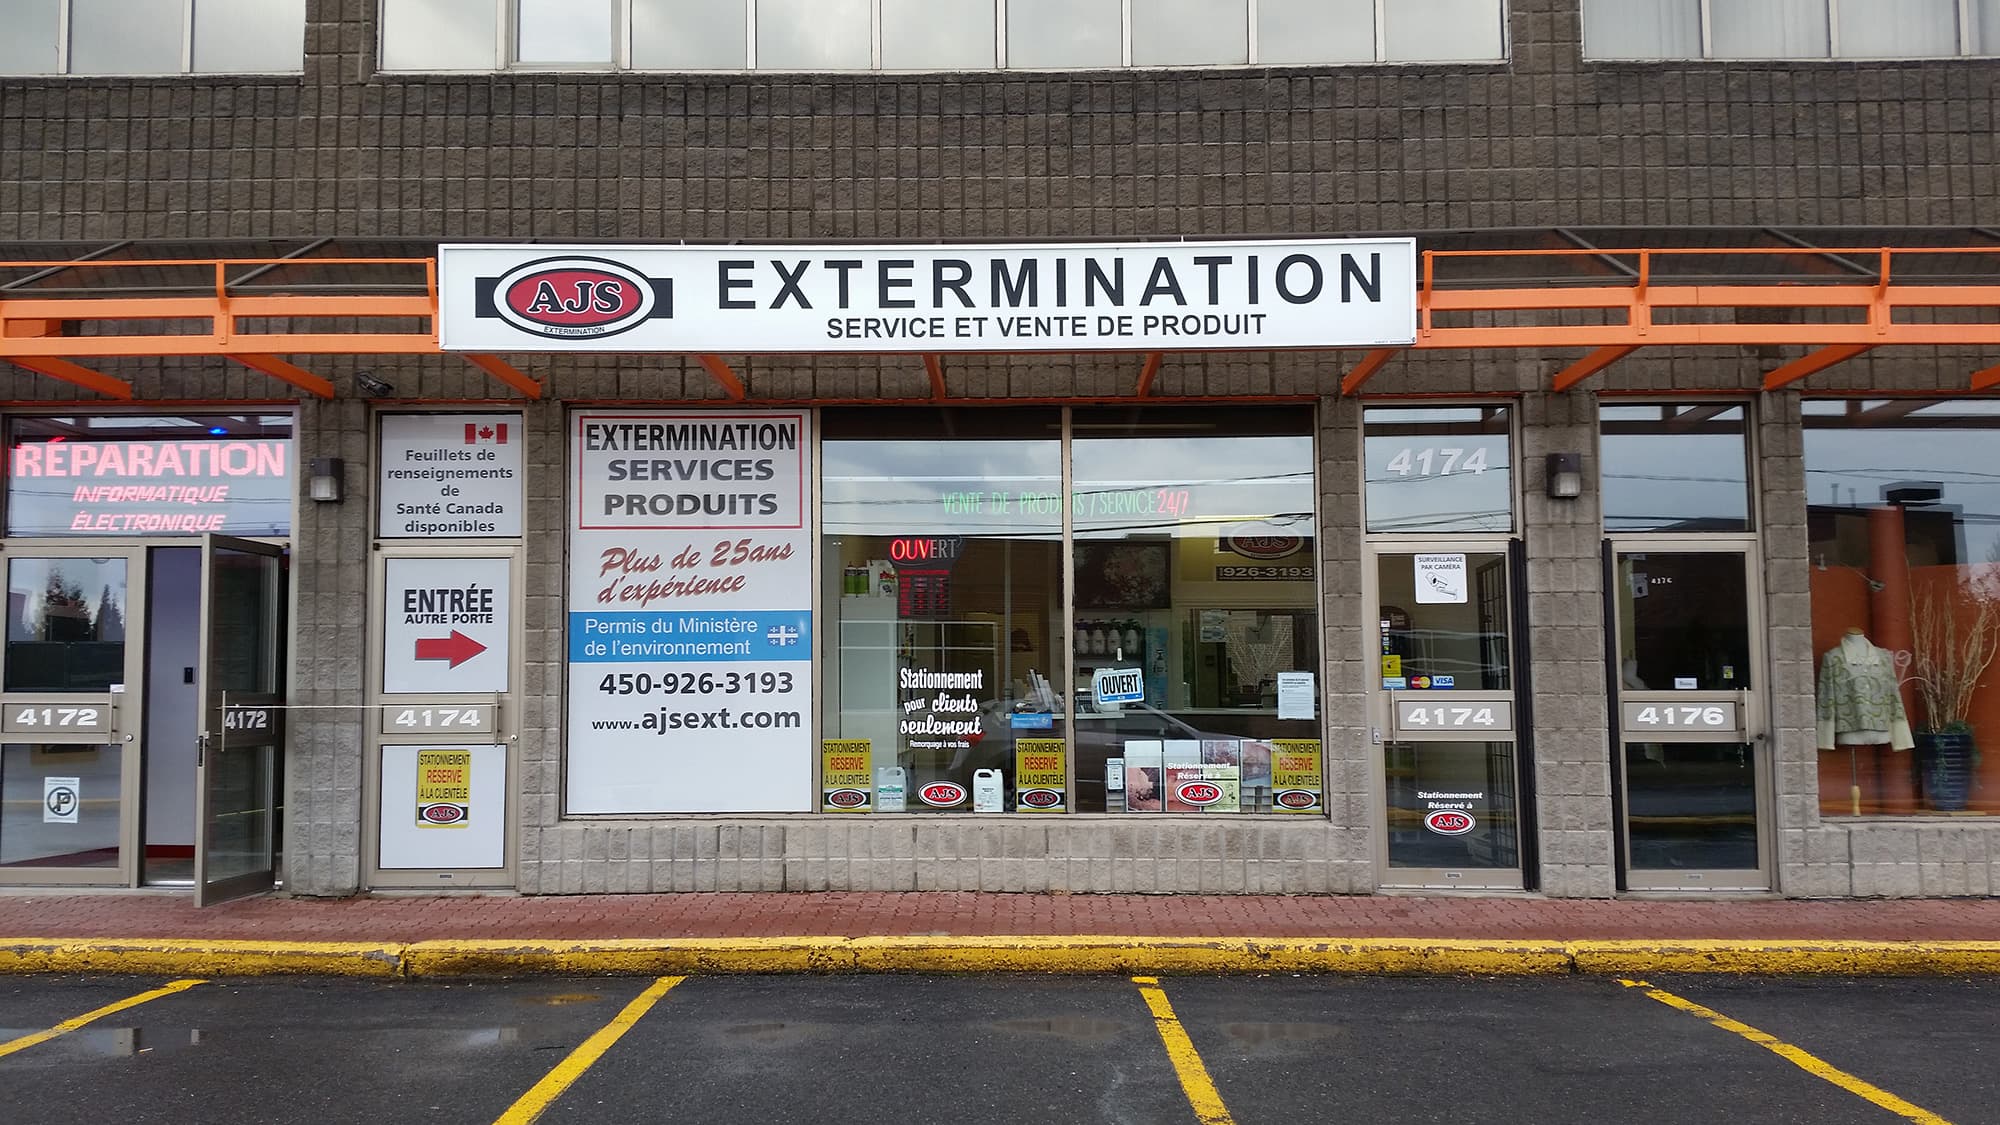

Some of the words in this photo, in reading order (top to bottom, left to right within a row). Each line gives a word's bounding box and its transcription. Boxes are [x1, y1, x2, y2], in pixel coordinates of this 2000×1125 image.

[718, 252, 1381, 309] EXTERMINATION
[527, 280, 623, 314] AJS
[543, 325, 605, 336] EXTERMINATION
[827, 317, 945, 339] SERVICE
[954, 316, 988, 338] ET
[997, 315, 1087, 338] VENTE
[1099, 315, 1133, 337] DE
[1144, 313, 1266, 337] PRODUIT
[586, 423, 796, 451] EXTERMINATION
[15, 437, 285, 477] RÉPARATION
[406, 449, 471, 461] Feuillets
[477, 449, 496, 461] de
[1387, 448, 1487, 475] 4174
[388, 467, 513, 481] renseignements
[608, 459, 775, 481] SERVICES
[72, 485, 229, 504] INFORMATIQUE
[441, 485, 460, 496] de
[397, 502, 441, 514] Santé
[446, 502, 503, 514] Canada
[604, 493, 778, 516] PRODUITS
[942, 491, 984, 515] VENTE
[992, 491, 1010, 515] DE
[71, 511, 227, 533] ÉLECTRONIQUE
[405, 520, 495, 535] disponibles
[600, 546, 664, 577] Plus
[671, 544, 702, 570] de
[710, 538, 795, 568] 25ans
[891, 538, 957, 560] OUVERT
[404, 583, 493, 613] ENTRÉE
[597, 574, 747, 608] d'expérience
[405, 614, 448, 624] AUTRE
[452, 613, 493, 624] PORTE
[585, 618, 646, 634] Permis
[651, 618, 673, 634] du
[679, 617, 758, 633] Ministère
[585, 640, 606, 656] de
[612, 640, 751, 656] l'environnement
[599, 672, 794, 695] 450-926-3193
[900, 667, 983, 689] Stationnement
[1102, 674, 1138, 694] OUVERT
[904, 698, 926, 715] pour
[932, 692, 978, 712] clients
[16, 709, 98, 726] 4172
[225, 710, 267, 729] 4172
[395, 709, 481, 727] 4174
[591, 707, 801, 735] www.ajsext.com
[1407, 707, 1495, 726] 4174
[1637, 706, 1725, 725] 4176
[900, 715, 983, 734] seulement
[823, 743, 870, 753] STATIONNEMENT
[1017, 742, 1065, 753] STATIONNEMENT
[420, 754, 471, 765] STATIONNEMENT
[830, 774, 837, 784] LA
[1024, 774, 1032, 784] LA
[1280, 775, 1287, 785] LA
[426, 788, 433, 798] LA
[837, 793, 859, 802] AJS
[929, 788, 957, 799] AJS
[1030, 793, 1054, 802] AJS
[1186, 788, 1214, 798] AJS
[1417, 791, 1483, 799] Stationnement
[431, 809, 456, 818] AJS
[1428, 801, 1465, 809] Réservé
[1436, 816, 1465, 828] AJS
